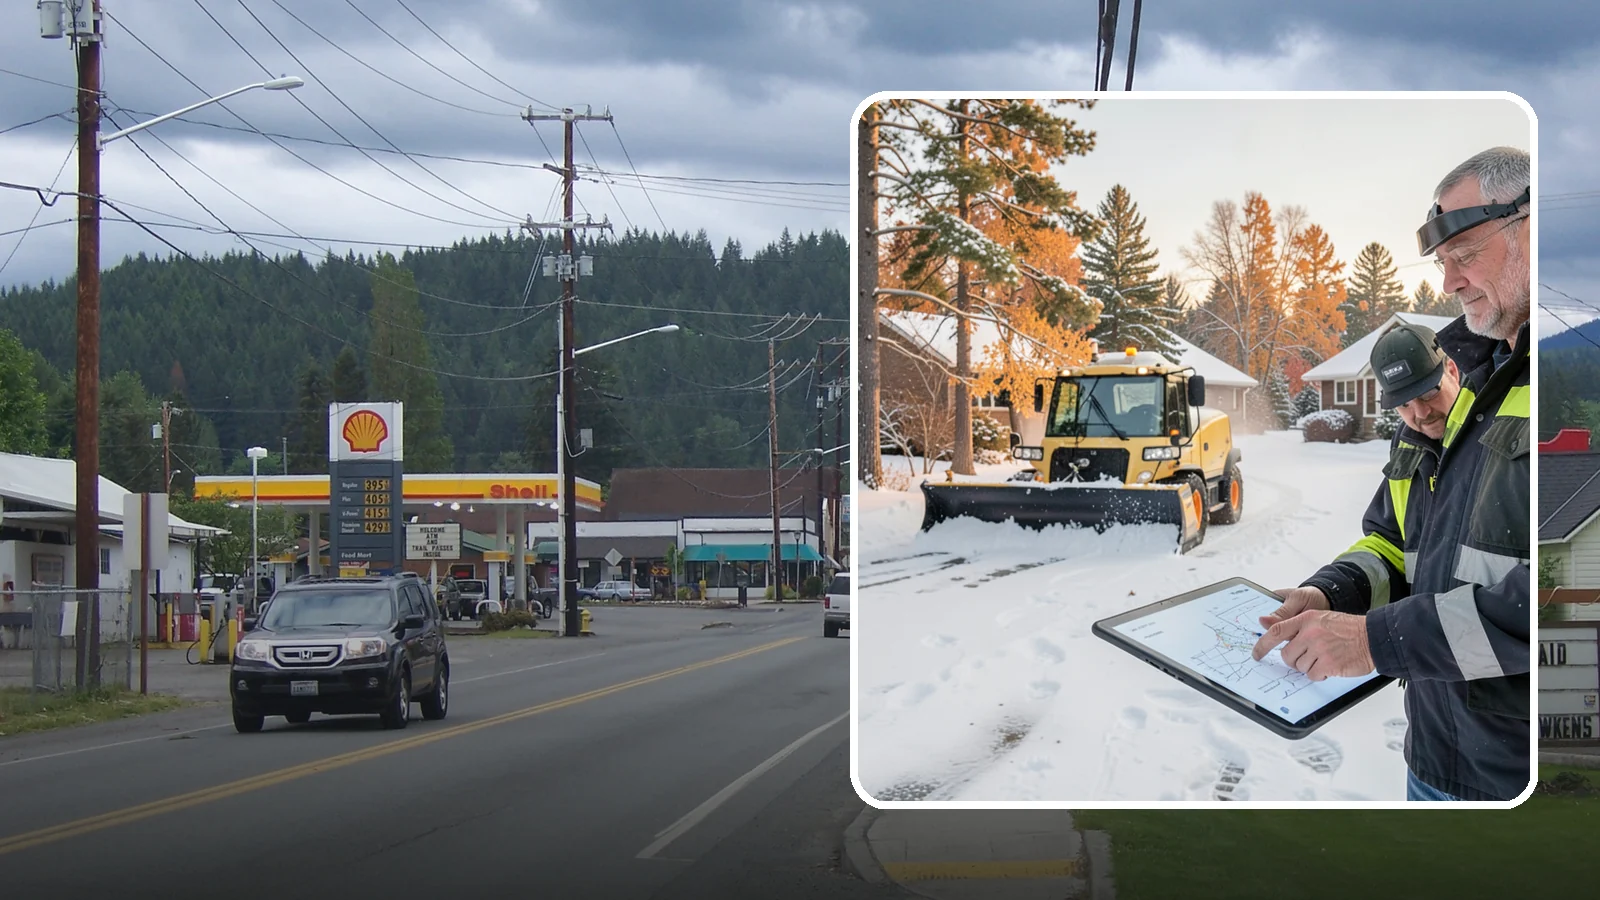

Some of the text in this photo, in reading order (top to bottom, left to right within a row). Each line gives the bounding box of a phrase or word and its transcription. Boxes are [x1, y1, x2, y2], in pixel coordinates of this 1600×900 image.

[366, 480, 384, 490] 395
[490, 484, 547, 499] Shell
[366, 494, 384, 504] 405
[366, 508, 384, 518] 415
[366, 522, 384, 532] 429
[1538, 642, 1566, 665] AID
